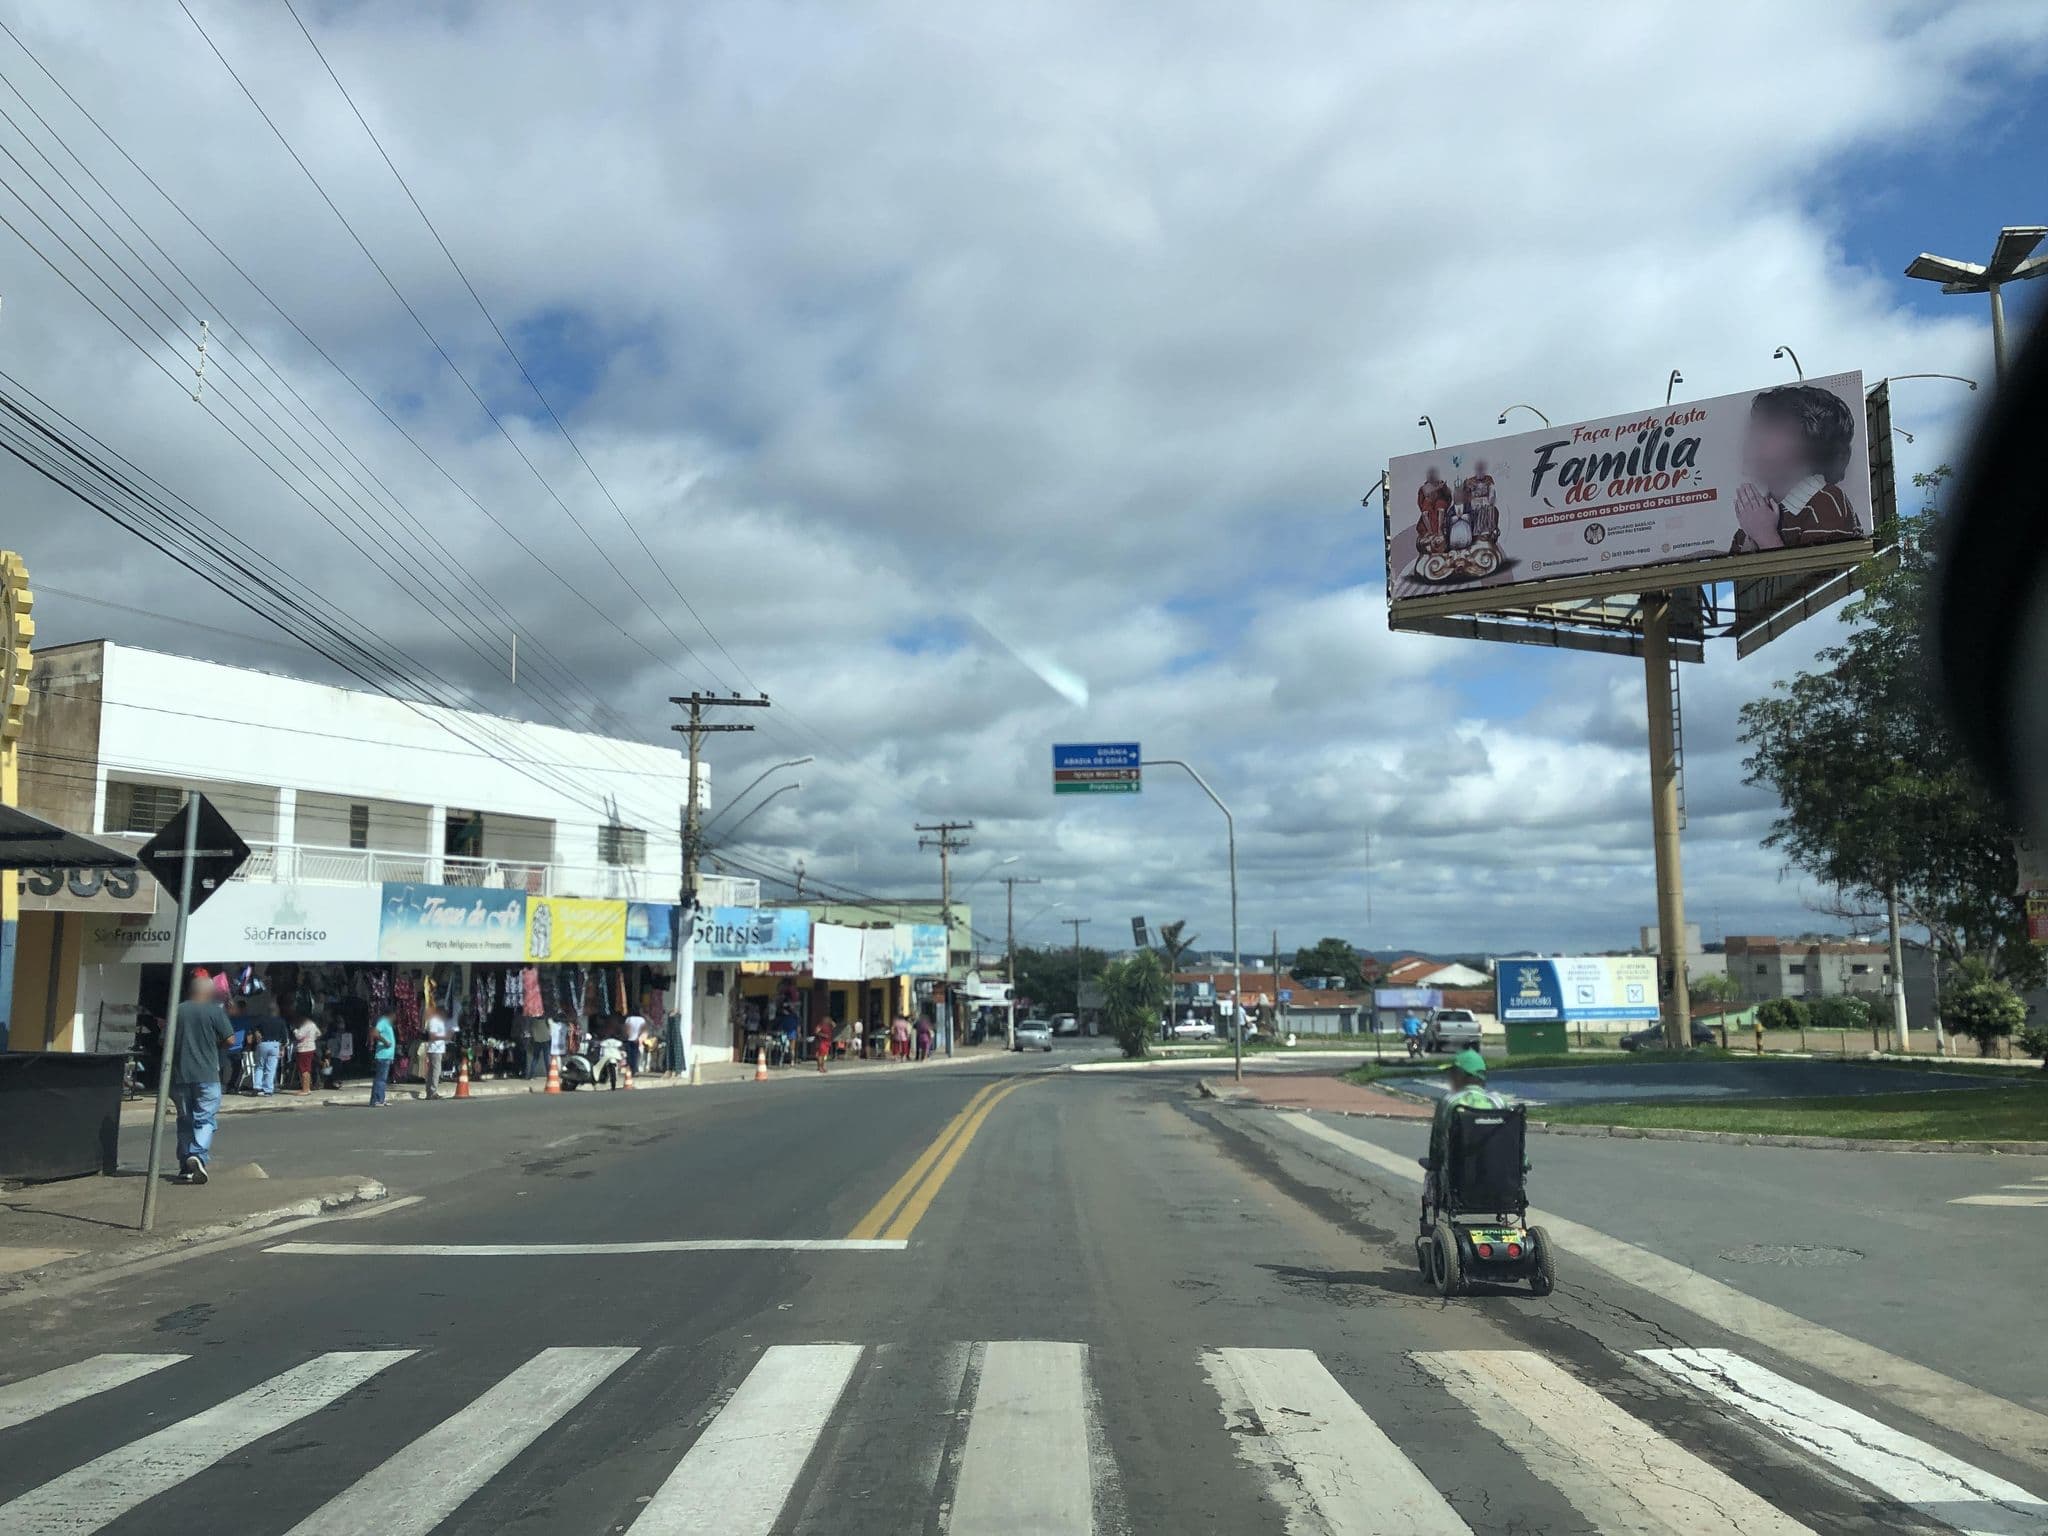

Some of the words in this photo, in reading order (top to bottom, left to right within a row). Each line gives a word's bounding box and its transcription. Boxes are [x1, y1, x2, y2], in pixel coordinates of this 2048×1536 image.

[1572, 425, 1610, 444] Faça
[1615, 416, 1660, 441] parte
[1664, 407, 1708, 427] desta
[1531, 426, 1701, 497] Família
[1565, 476, 1600, 505] de
[1607, 467, 1690, 498] amor
[1531, 513, 1575, 525] Colabore
[1576, 509, 1598, 518] com
[1599, 507, 1611, 515] as
[1612, 503, 1641, 513] obras
[1643, 500, 1656, 508] do
[1657, 497, 1674, 506] Pai
[1675, 492, 1712, 504] Eterno.
